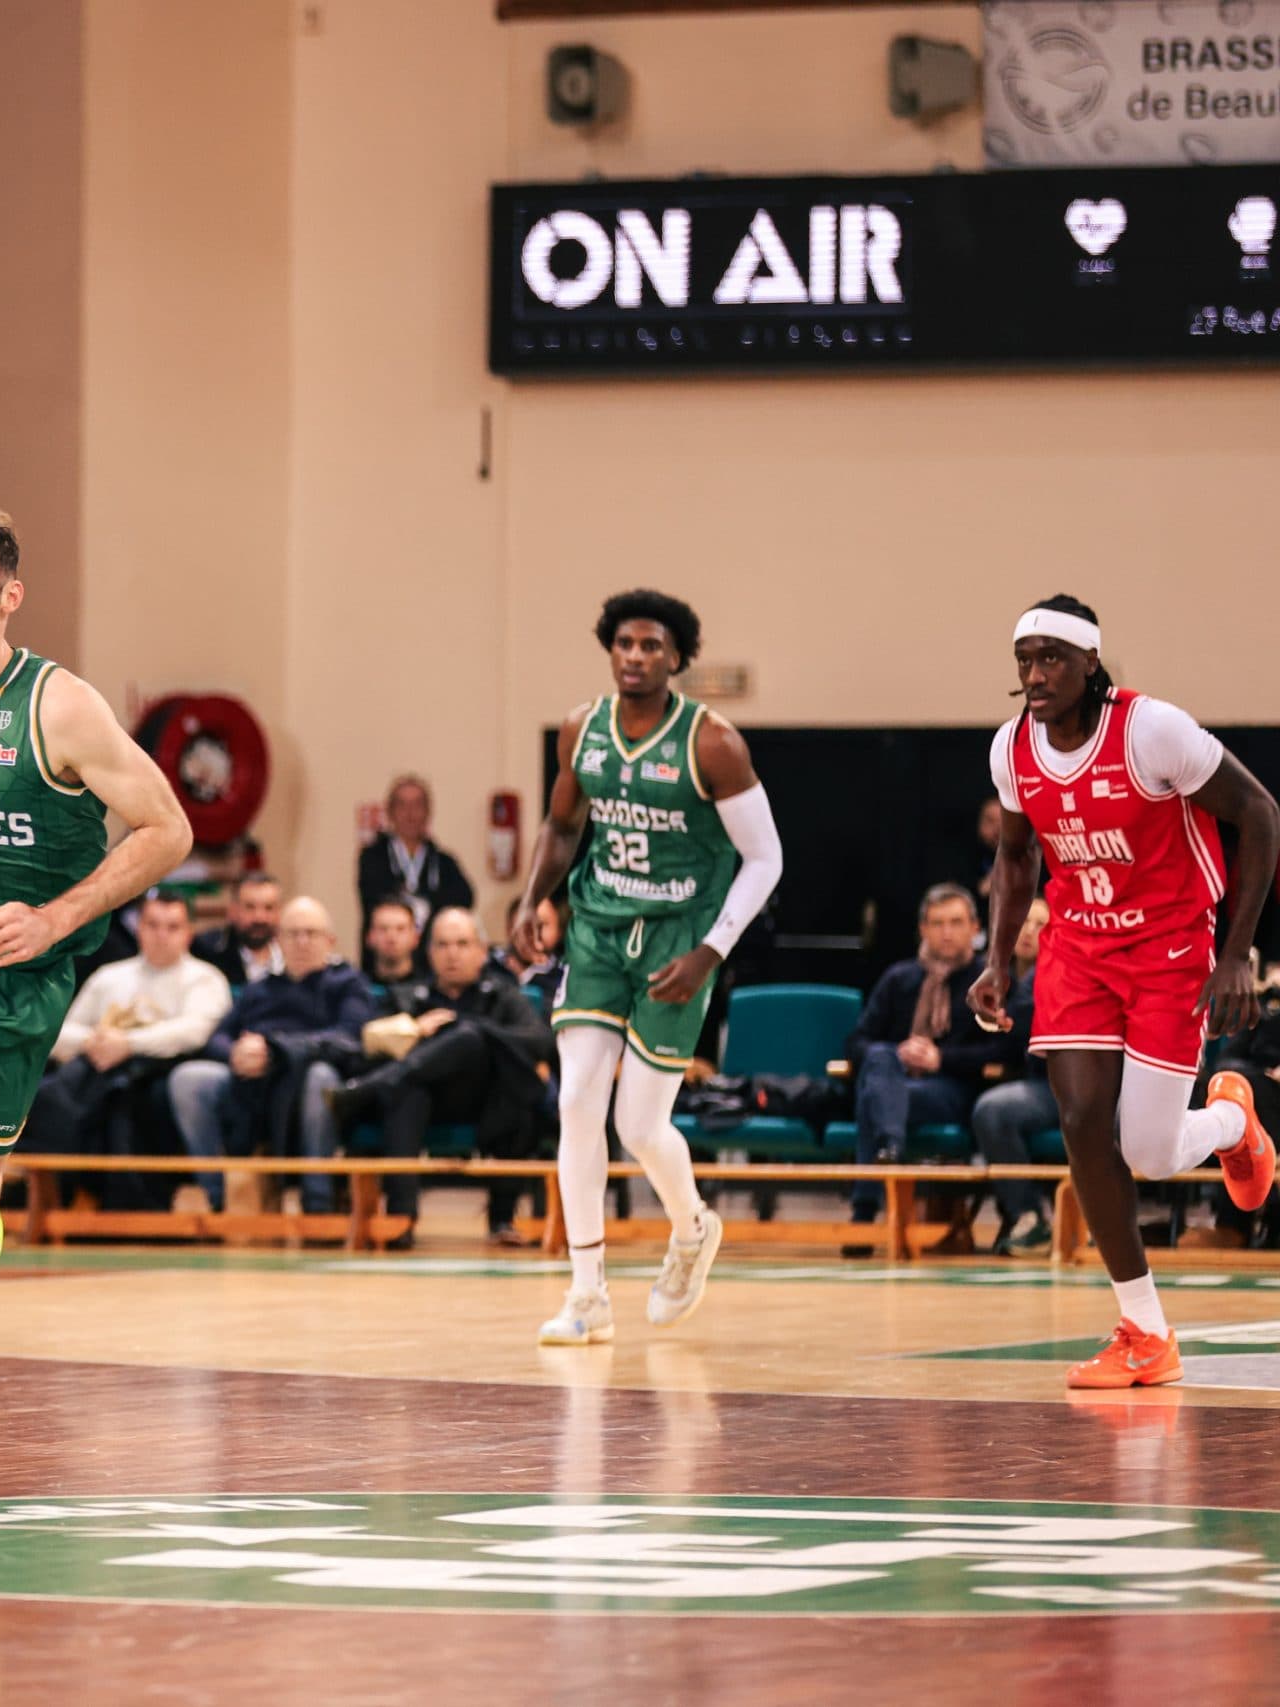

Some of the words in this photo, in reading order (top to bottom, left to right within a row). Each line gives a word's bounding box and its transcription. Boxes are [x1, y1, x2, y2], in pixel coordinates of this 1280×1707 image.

[1142, 35, 1280, 72] BRASS
[1126, 84, 1171, 120] de
[1186, 83, 1280, 119] Beau
[521, 208, 691, 309] ON
[713, 204, 905, 305] AIR
[607, 829, 650, 874] 32
[1074, 866, 1113, 906] 13
